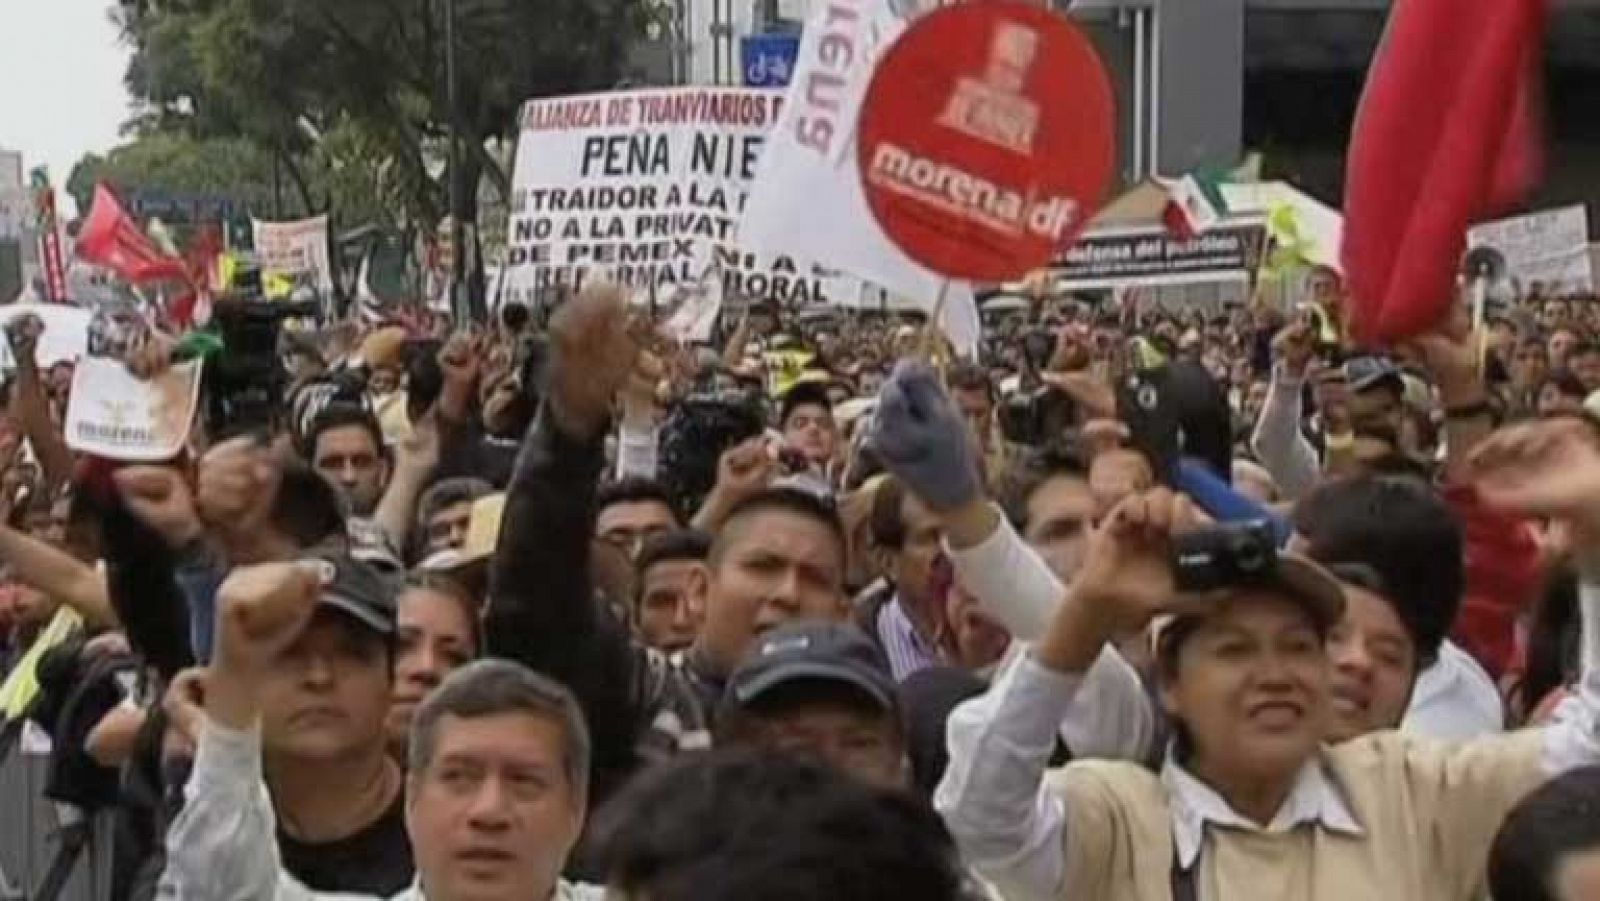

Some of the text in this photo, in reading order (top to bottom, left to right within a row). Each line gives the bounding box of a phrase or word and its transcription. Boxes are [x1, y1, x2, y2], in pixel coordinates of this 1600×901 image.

[607, 96, 635, 126] DE
[532, 184, 657, 212] TRAIDOR
[666, 184, 682, 206] A
[689, 182, 728, 211] LA
[868, 143, 1022, 222] morena
[515, 216, 553, 242] NO
[561, 218, 581, 240] A
[590, 215, 625, 238] LA
[508, 246, 550, 266] DE
[567, 238, 695, 264] PEMEX
